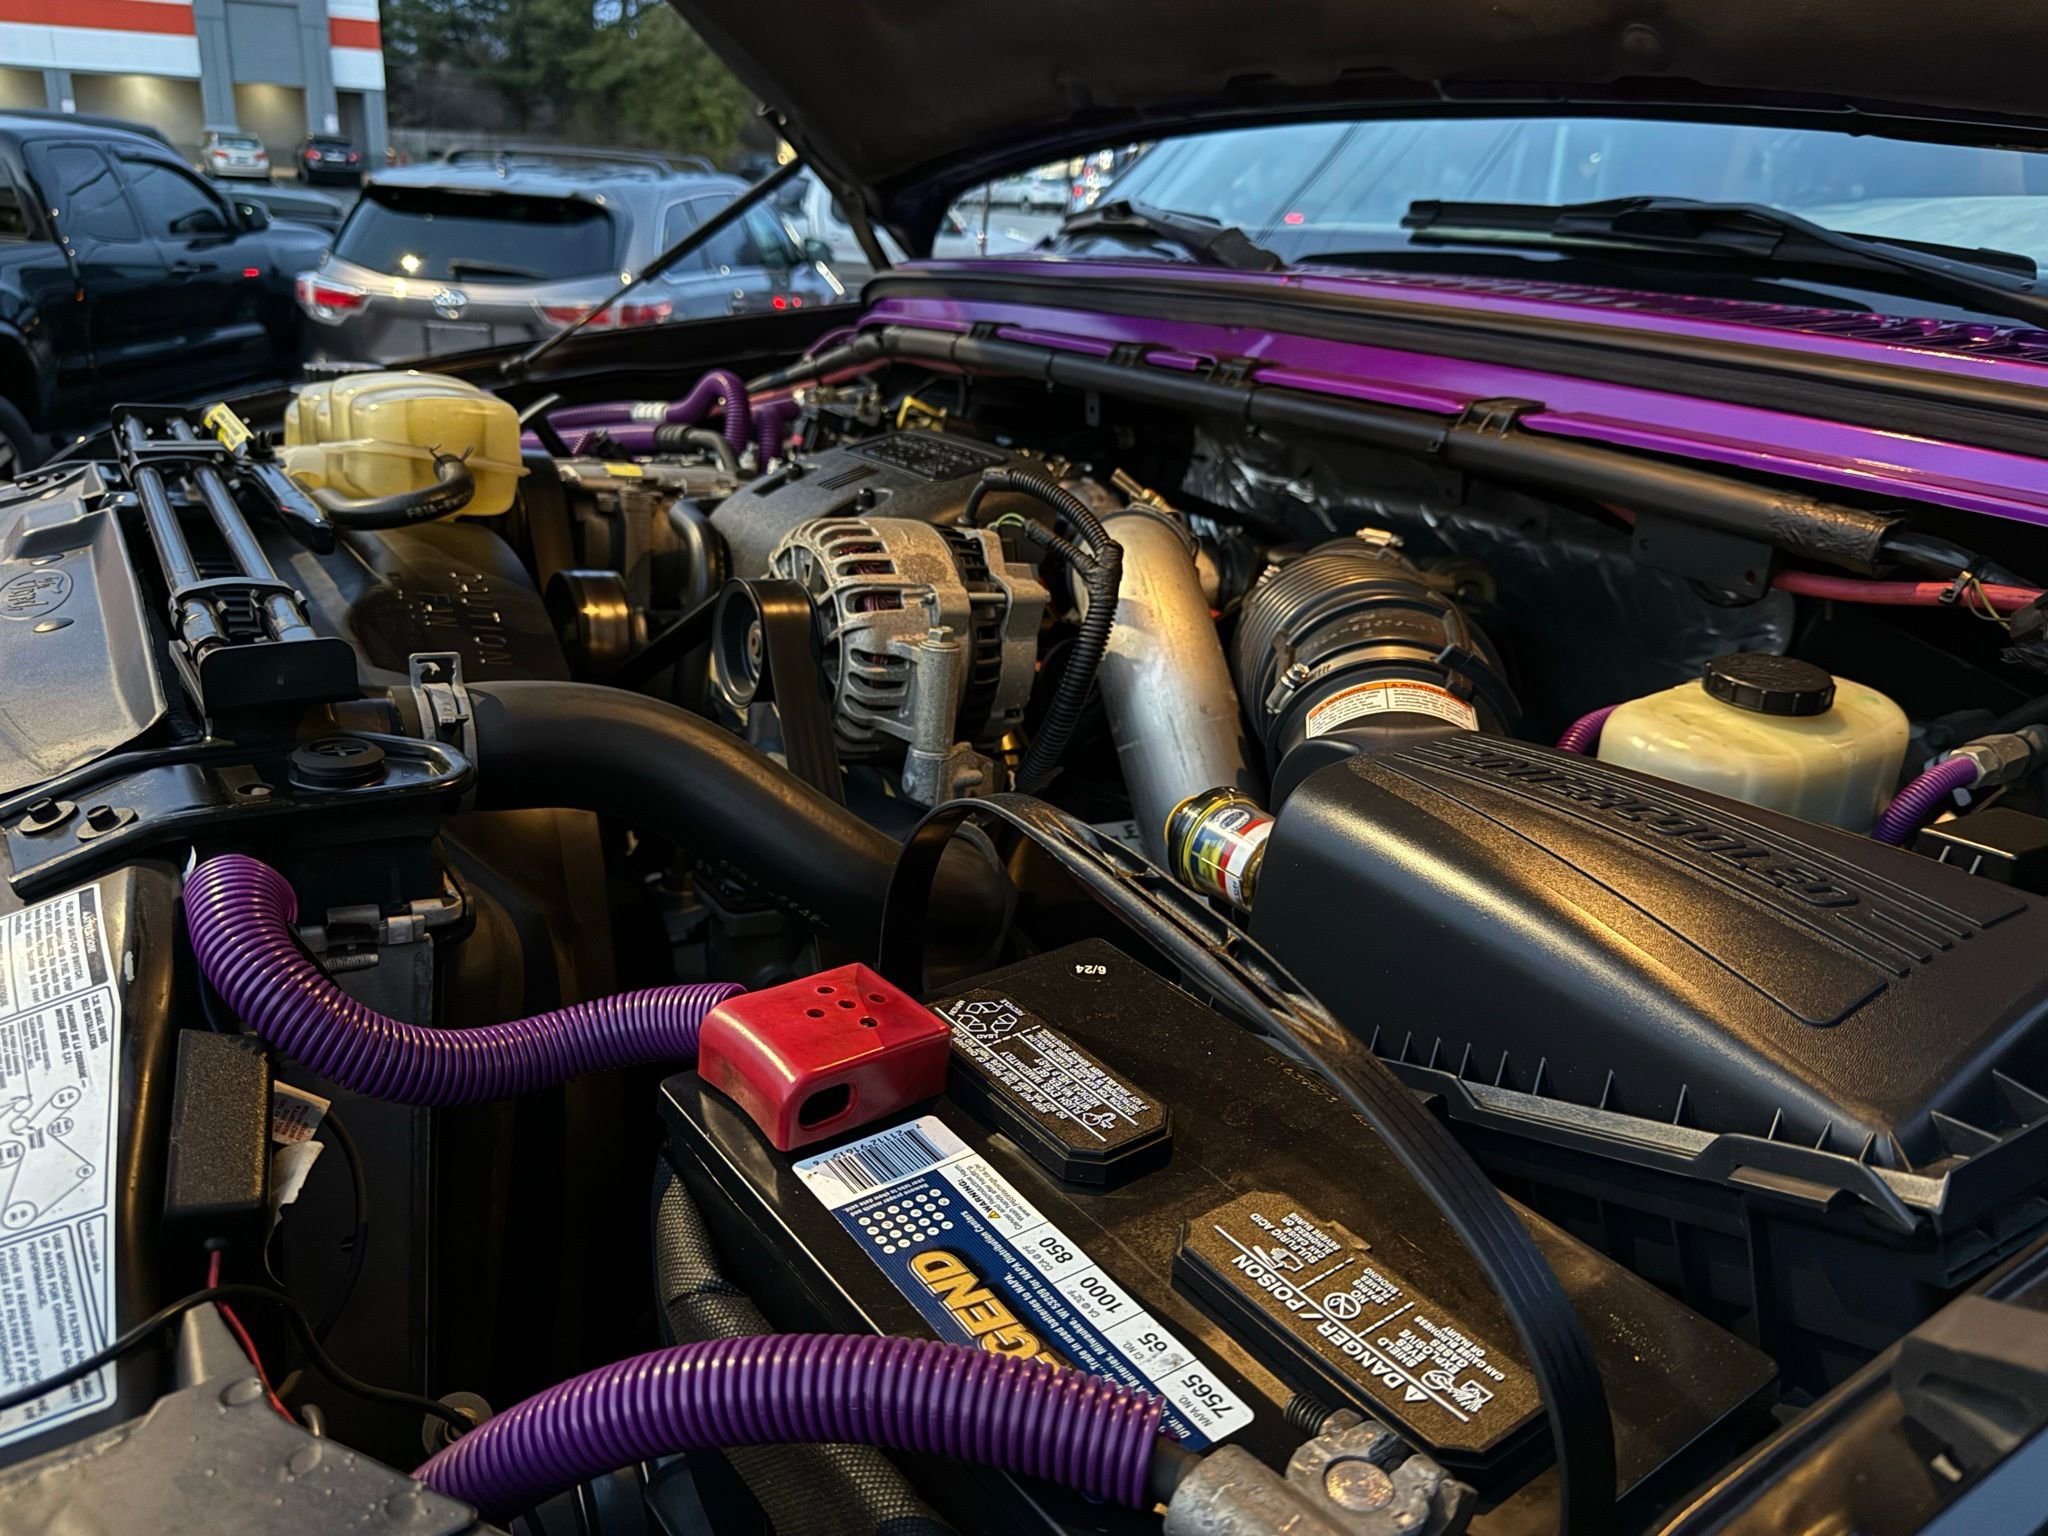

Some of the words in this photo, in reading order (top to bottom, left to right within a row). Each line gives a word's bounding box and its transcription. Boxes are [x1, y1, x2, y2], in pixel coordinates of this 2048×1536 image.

[1074, 963, 1106, 975] 6/24
[999, 1050, 1045, 1083] IMMEDIATELY
[1032, 1065, 1051, 1077] GET
[1033, 1056, 1056, 1071] FAST
[1017, 1080, 1035, 1092] KEEP
[1050, 1069, 1073, 1084] HELP
[1010, 1084, 1023, 1092] OF
[1019, 1091, 1035, 1101] OUT
[1039, 1082, 1062, 1097] EYES
[1068, 1083, 1102, 1106] MEDICAL
[1030, 1100, 1050, 1113] KEEP
[1042, 1101, 1059, 1111] NOT
[1057, 1096, 1084, 1114] FLUSH
[1069, 1095, 1093, 1110] WITH
[1054, 1110, 1068, 1119] DO
[869, 1129, 903, 1146] 21112
[955, 1178, 993, 1212] WARNING:
[982, 1183, 998, 1194] after
[992, 1203, 1006, 1214] and
[1007, 1207, 1024, 1221] Wash
[957, 1210, 985, 1233] Centers
[1001, 1212, 1023, 1230] Cancer
[1248, 1211, 1275, 1231] ACID
[1280, 1216, 1295, 1226] OR
[1288, 1211, 1315, 1231] BURNS
[1269, 1227, 1319, 1264] SULFURIC
[1283, 1226, 1310, 1246] CAUSE
[1292, 1225, 1334, 1254] BLINDNESS
[1310, 1228, 1341, 1250] SEVERE
[978, 1230, 1016, 1264] Distribution
[1036, 1235, 1074, 1265] 850
[1307, 1244, 1326, 1258] CAN
[1009, 1261, 1033, 1281] NAPA
[1037, 1258, 1053, 1271] CCA
[1026, 1278, 1042, 1290] for
[1229, 1252, 1307, 1311] POISON
[1019, 1290, 1033, 1301] to
[1035, 1287, 1062, 1310] 53209
[1077, 1274, 1124, 1314] 1000
[1349, 1288, 1370, 1303] NO
[1026, 1297, 1060, 1328] batteries
[1055, 1306, 1071, 1319] WI
[1086, 1307, 1100, 1318] CA
[1054, 1325, 1076, 1344] used
[1065, 1316, 1107, 1355] Milwaukee,
[1413, 1314, 1460, 1348] BLINDNESS
[1441, 1324, 1474, 1347] INJURY
[1069, 1341, 1083, 1351] in
[1136, 1331, 1168, 1355] 65
[1374, 1335, 1418, 1368] SHIELD
[1394, 1337, 1427, 1361] EYES
[1398, 1328, 1460, 1374] EXPLOSIVE
[1468, 1344, 1487, 1357] OR
[1314, 1319, 1406, 1389] DANGER
[1428, 1338, 1470, 1368] GASES
[1455, 1345, 1488, 1368] CAUSE
[1101, 1352, 1140, 1388] Batteries,
[1482, 1364, 1506, 1381] CAN
[1176, 1395, 1193, 1407] NO.
[1180, 1373, 1233, 1416] 7565
[1187, 1405, 1213, 1426] NAPA
